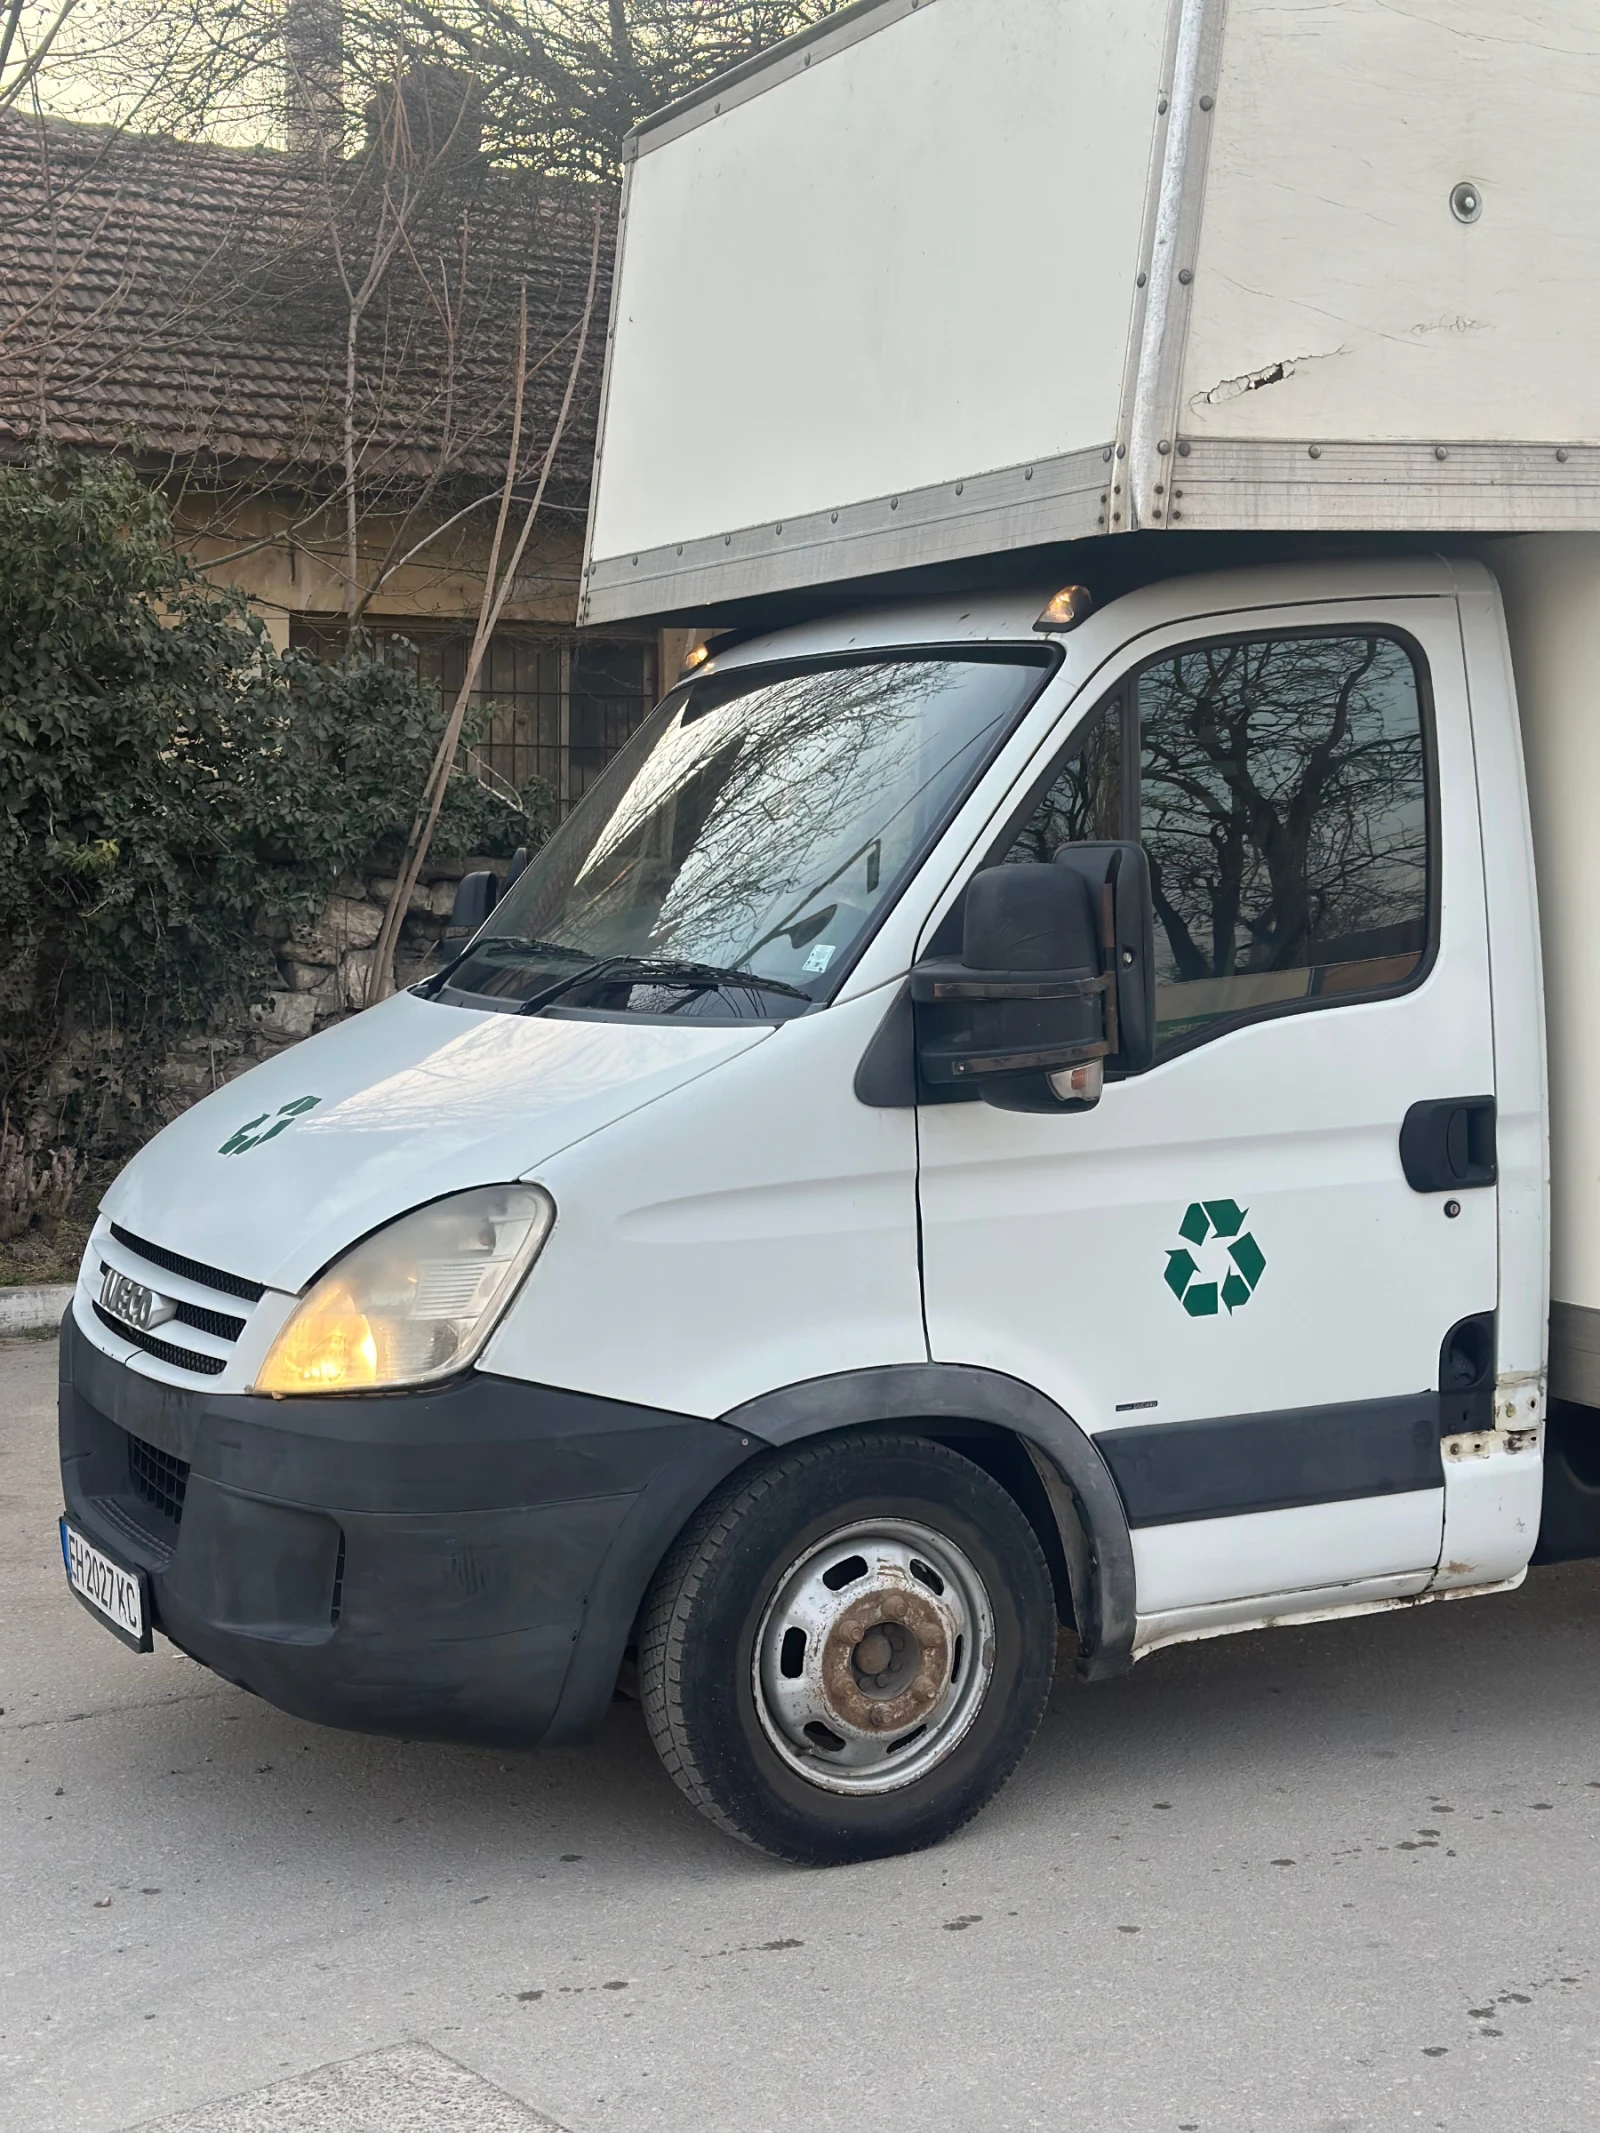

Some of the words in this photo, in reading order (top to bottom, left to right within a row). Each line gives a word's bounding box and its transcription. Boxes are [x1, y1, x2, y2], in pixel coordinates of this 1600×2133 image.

[100, 1268, 153, 1331] IVECO
[69, 1534, 85, 1588] EH
[85, 1549, 114, 1611] 2027
[116, 1573, 137, 1628] KC
